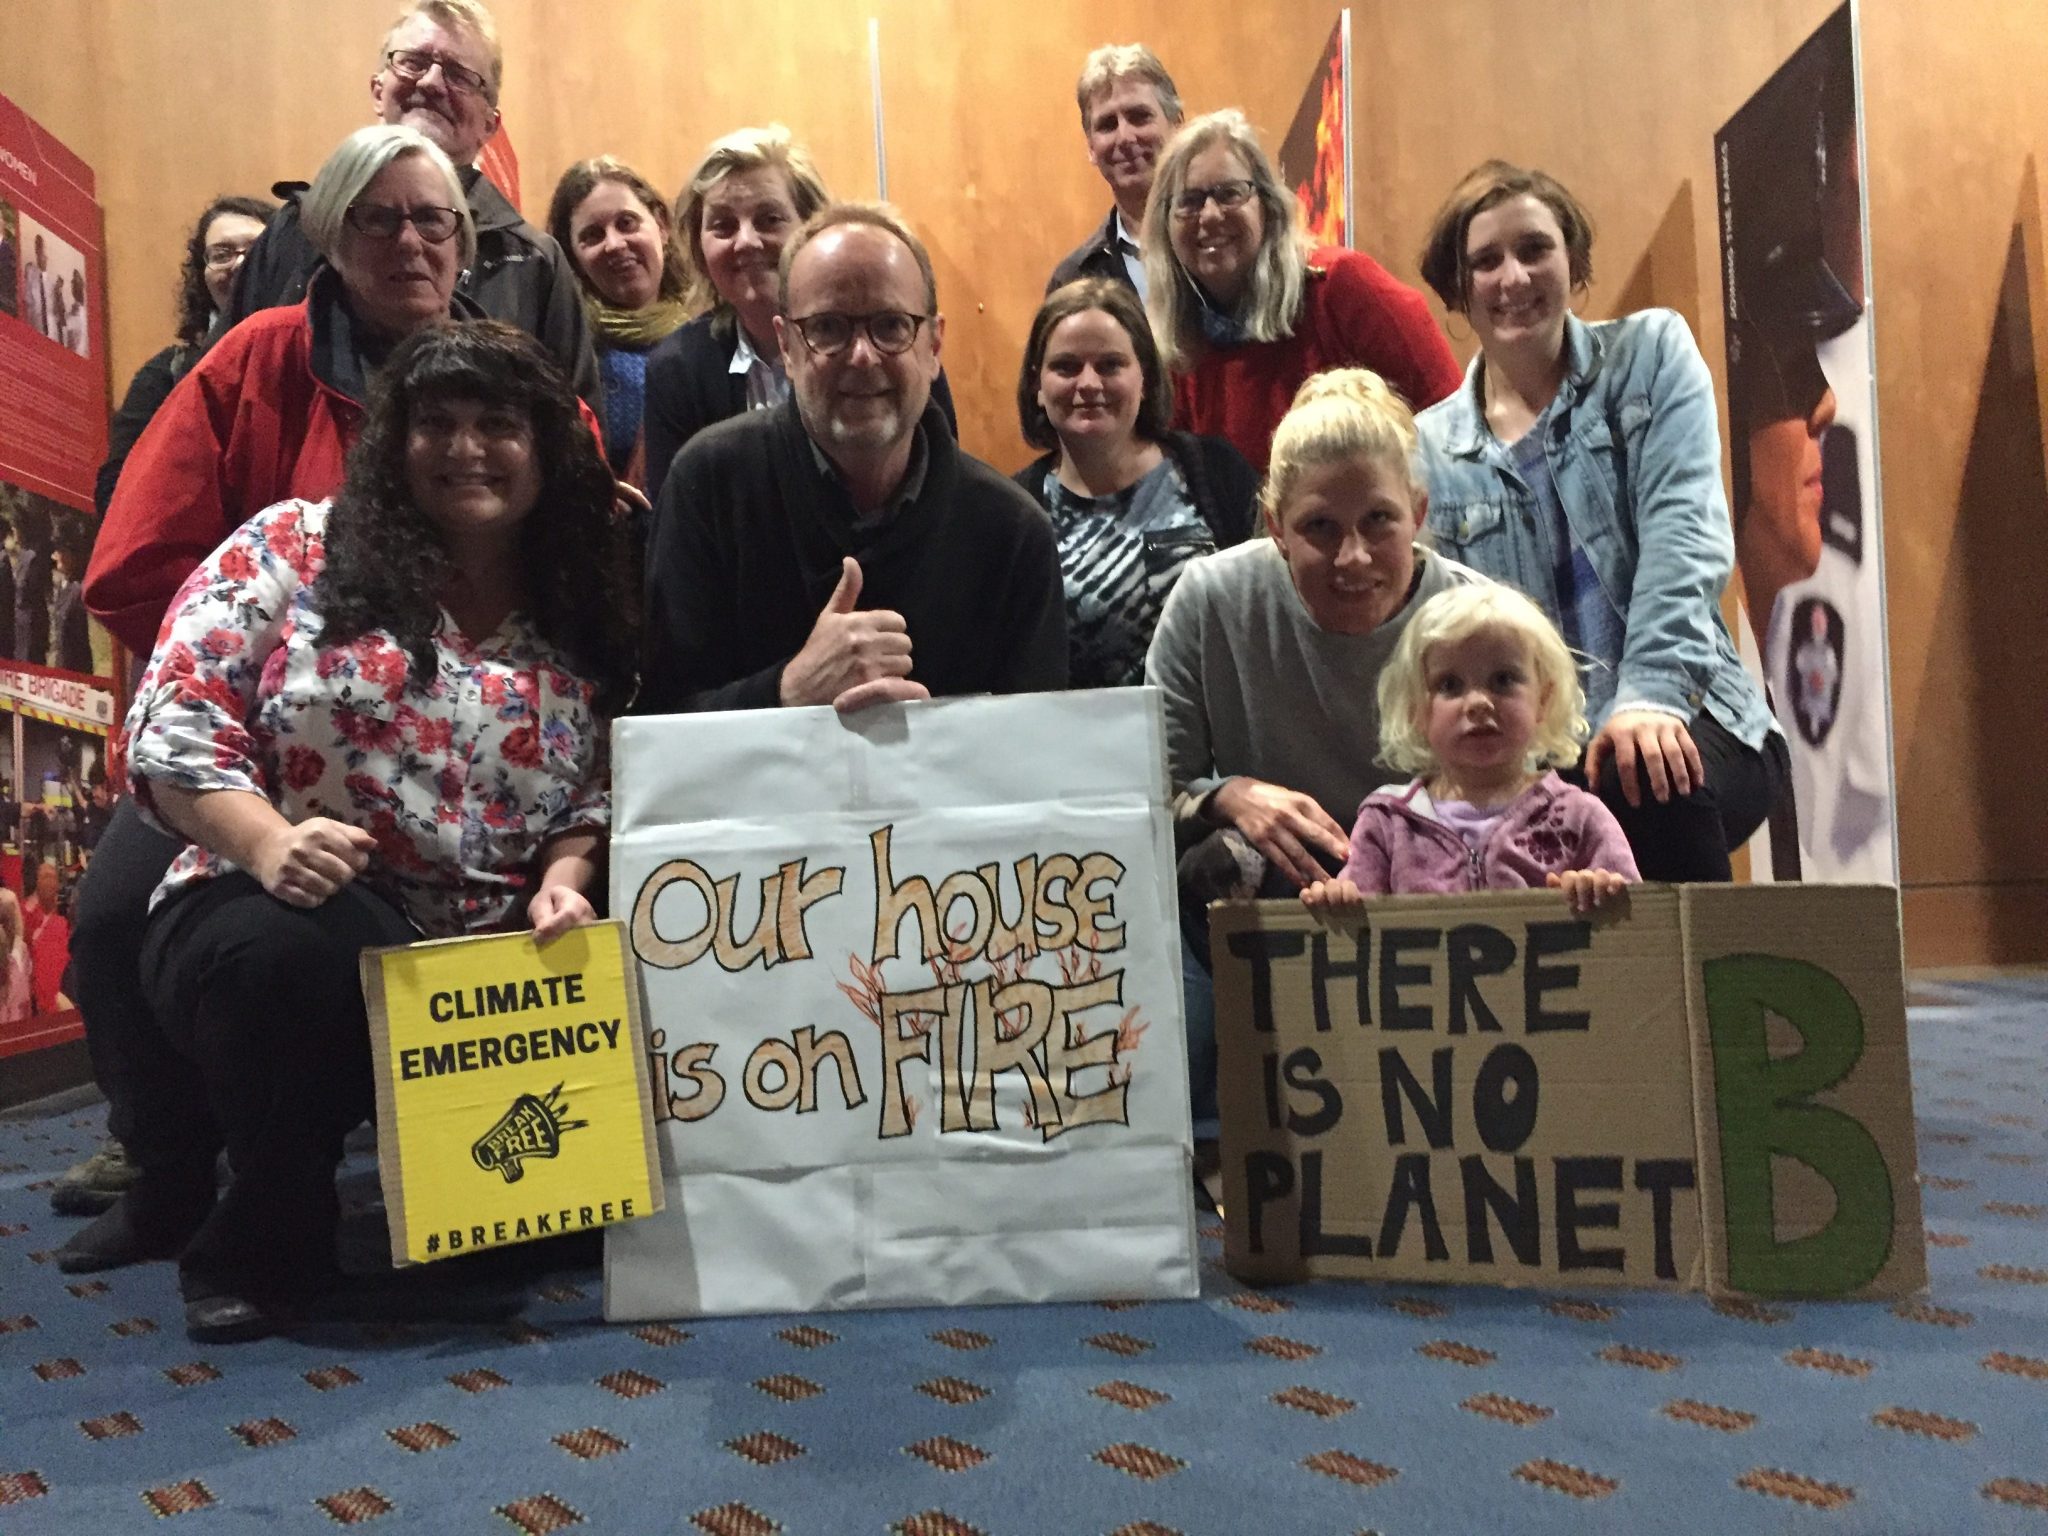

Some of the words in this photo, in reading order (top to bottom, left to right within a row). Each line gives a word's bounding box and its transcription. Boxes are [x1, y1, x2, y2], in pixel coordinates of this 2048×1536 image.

[29, 674, 85, 711] BRIGADE
[630, 857, 846, 972] Our
[429, 973, 586, 1023] CLIMATE
[1227, 921, 1593, 1035] THERE
[400, 1018, 621, 1081] EMERGENCY
[650, 1028, 727, 1123] is
[743, 1024, 868, 1114] on
[879, 969, 1131, 1143] FIRE
[486, 1104, 536, 1151] BREAK
[494, 1116, 551, 1160] FREE
[1262, 1046, 1343, 1138] IS
[1378, 1043, 1539, 1153] NO
[1703, 952, 1894, 1301] B
[426, 1199, 636, 1254] #BREAKFREE
[1245, 1150, 1697, 1280] PLANET
